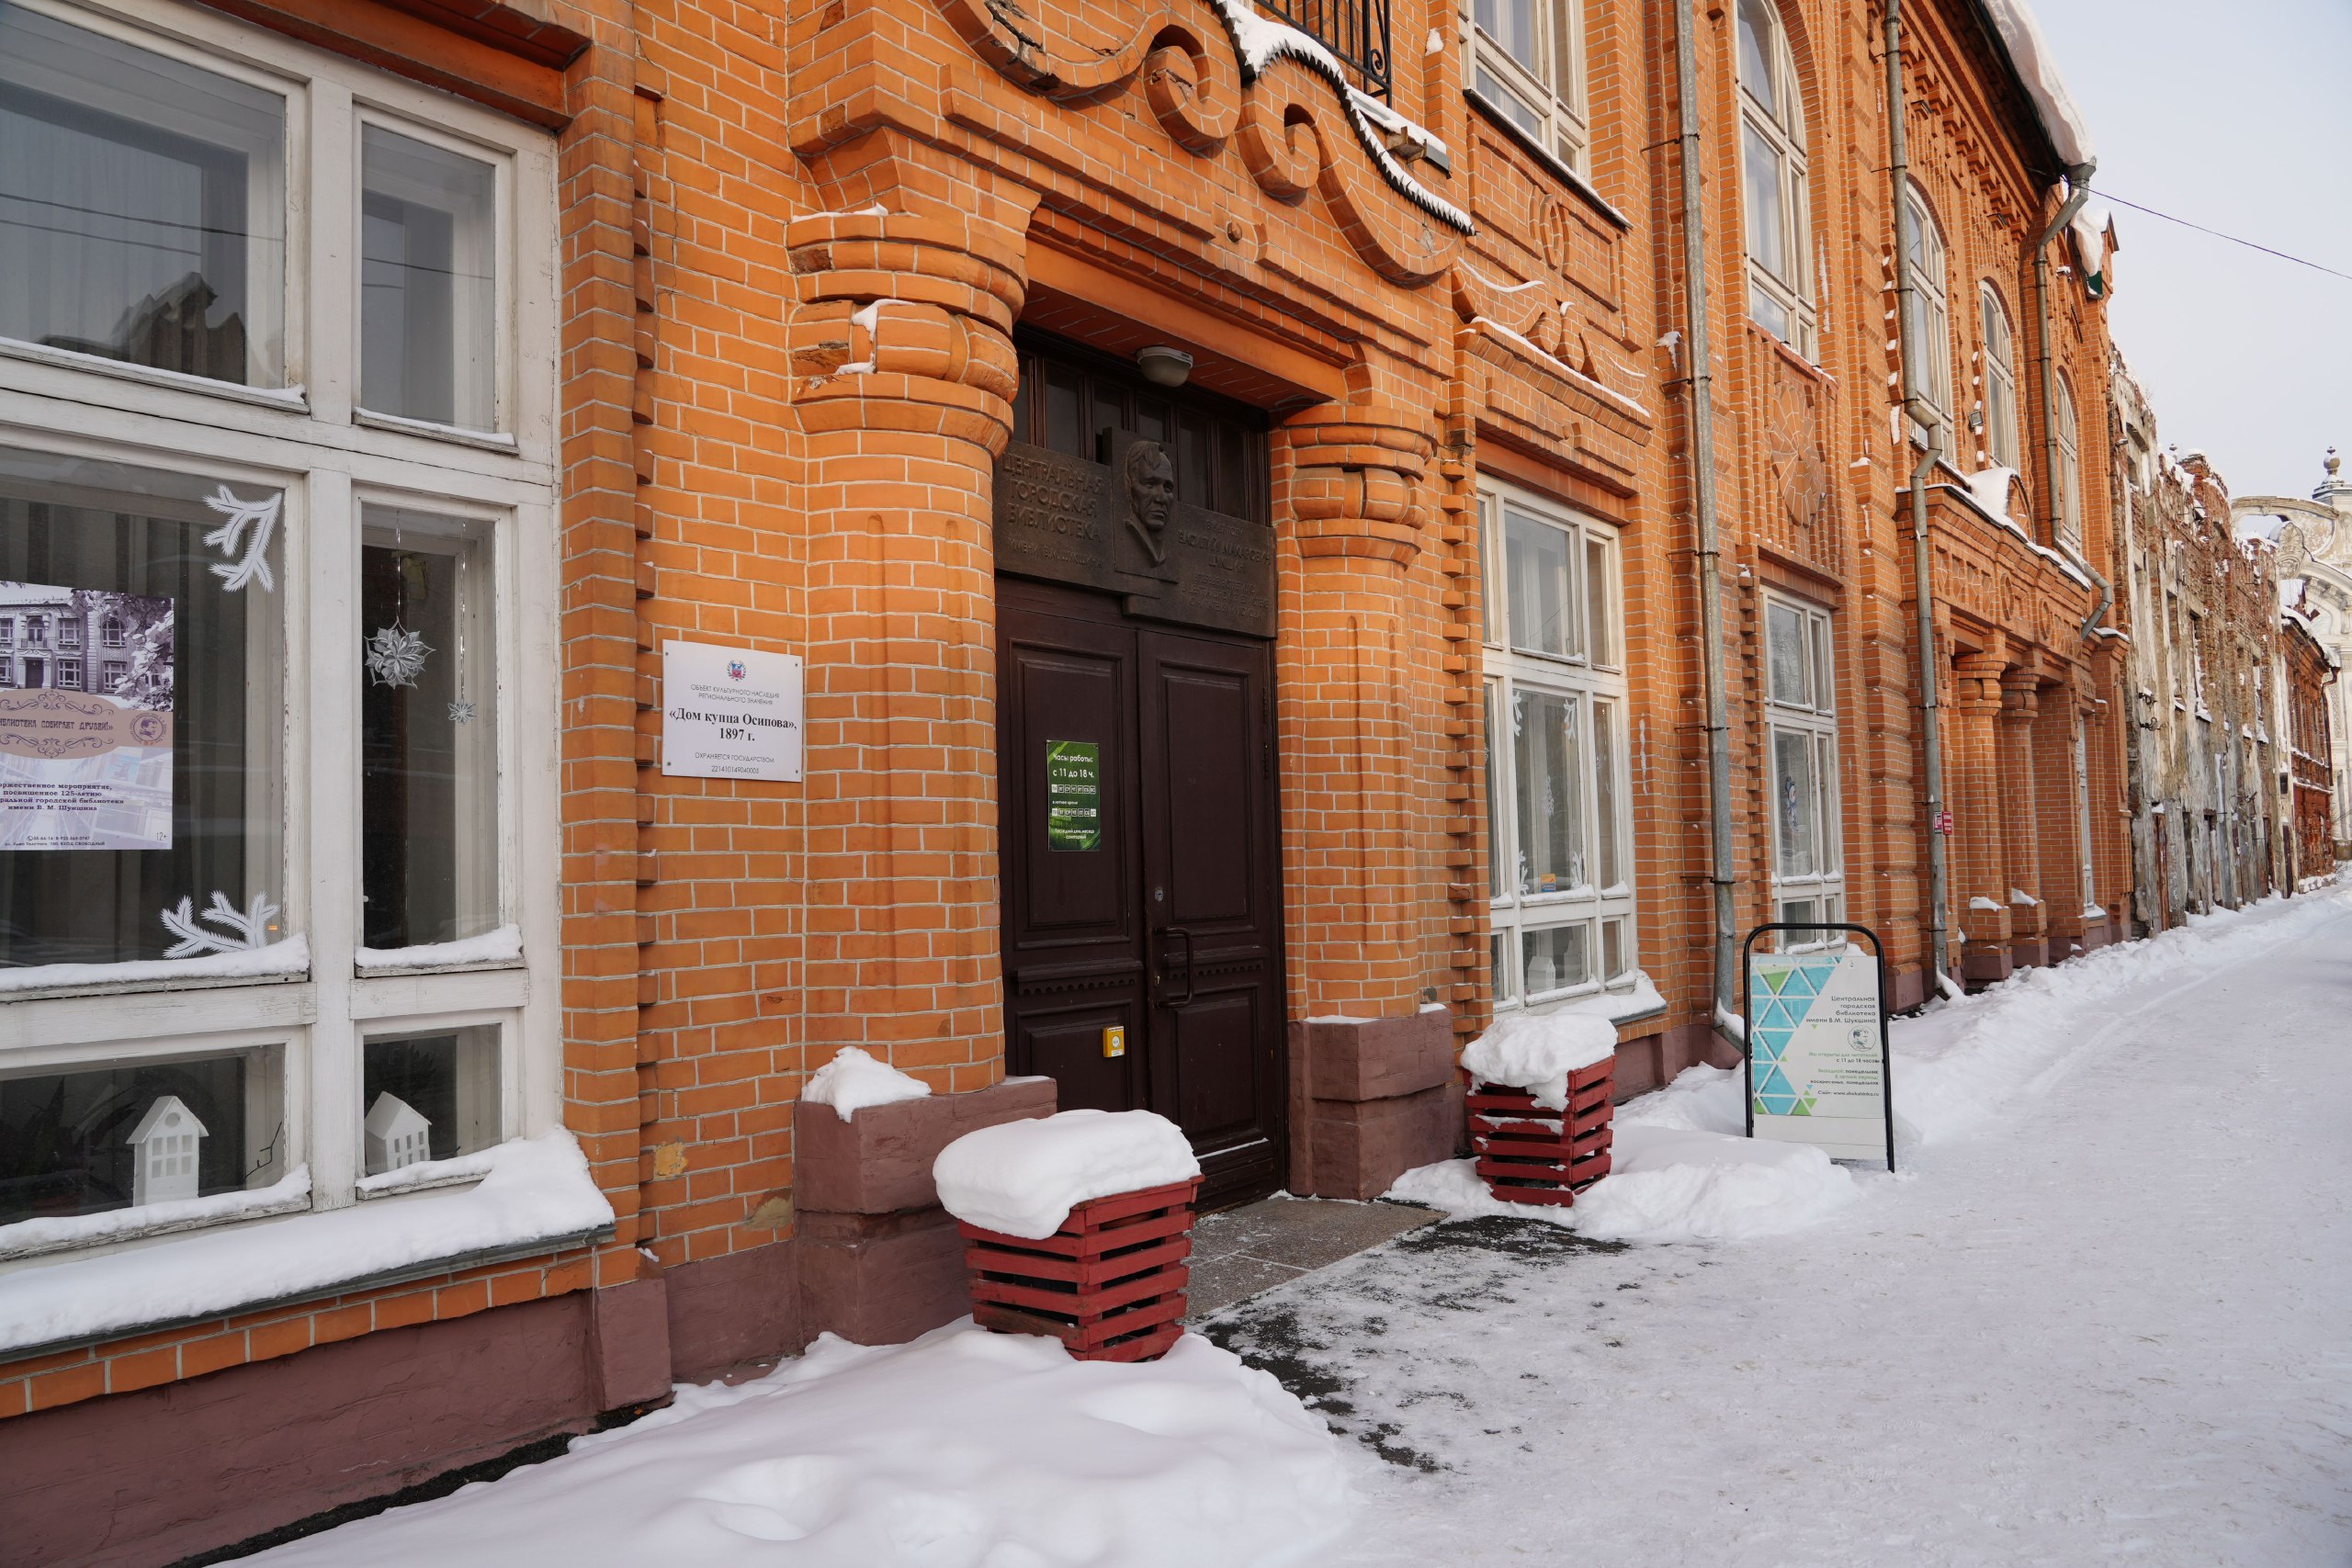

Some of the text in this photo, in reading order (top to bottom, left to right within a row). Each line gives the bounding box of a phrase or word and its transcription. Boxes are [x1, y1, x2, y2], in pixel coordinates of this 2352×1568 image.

[1002, 452, 1104, 496] ЦЕНТРАЛЬНАЯ
[1009, 478, 1099, 518] ГОРОДСКАЯ
[1007, 502, 1101, 544] БИБЛИОТЕКА
[691, 683, 779, 699] ОБЪЕКТ КУЛЬТУРНОГО НАСЛЕДИЯ
[698, 693, 746, 704] РЕГИОНАЛЬНОГО
[41, 720, 75, 729] СОБИРАЕТ
[669, 708, 797, 730] «Дом купца Осипова»,
[719, 728, 755, 741] 1897 г.
[695, 752, 775, 763] ОХРАНЯЕТСЯ ГОСУДАРСТВОМ
[1053, 753, 1093, 763] Часы работы:
[1059, 768, 1067, 777] 11
[1068, 770, 1078, 778] до
[1080, 769, 1088, 778] 18
[156, 831, 167, 841] 12+
